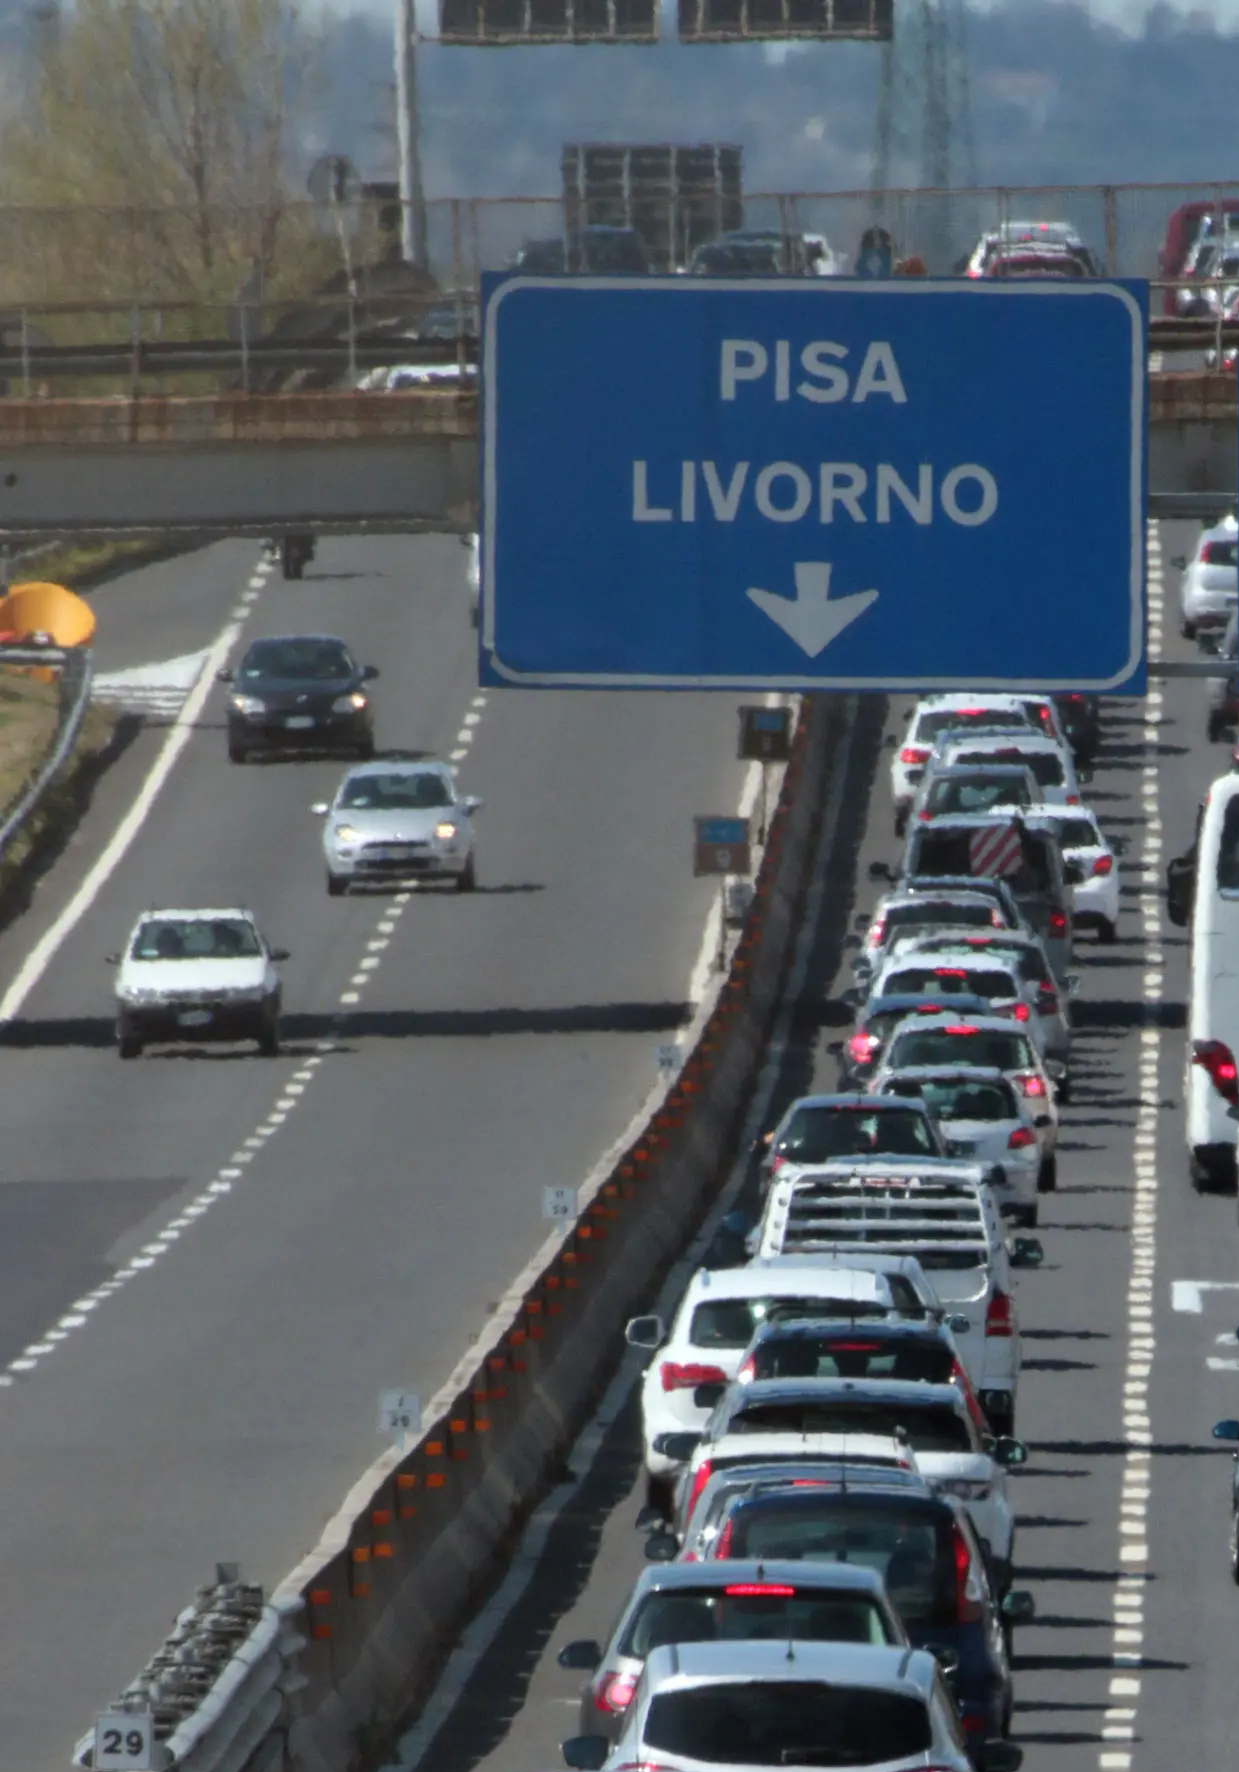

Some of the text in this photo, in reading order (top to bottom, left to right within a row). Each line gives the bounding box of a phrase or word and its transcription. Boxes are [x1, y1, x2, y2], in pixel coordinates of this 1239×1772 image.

[720, 338, 908, 404] PISA
[631, 460, 999, 527] LIVORNO
[102, 1728, 144, 1757] 29
